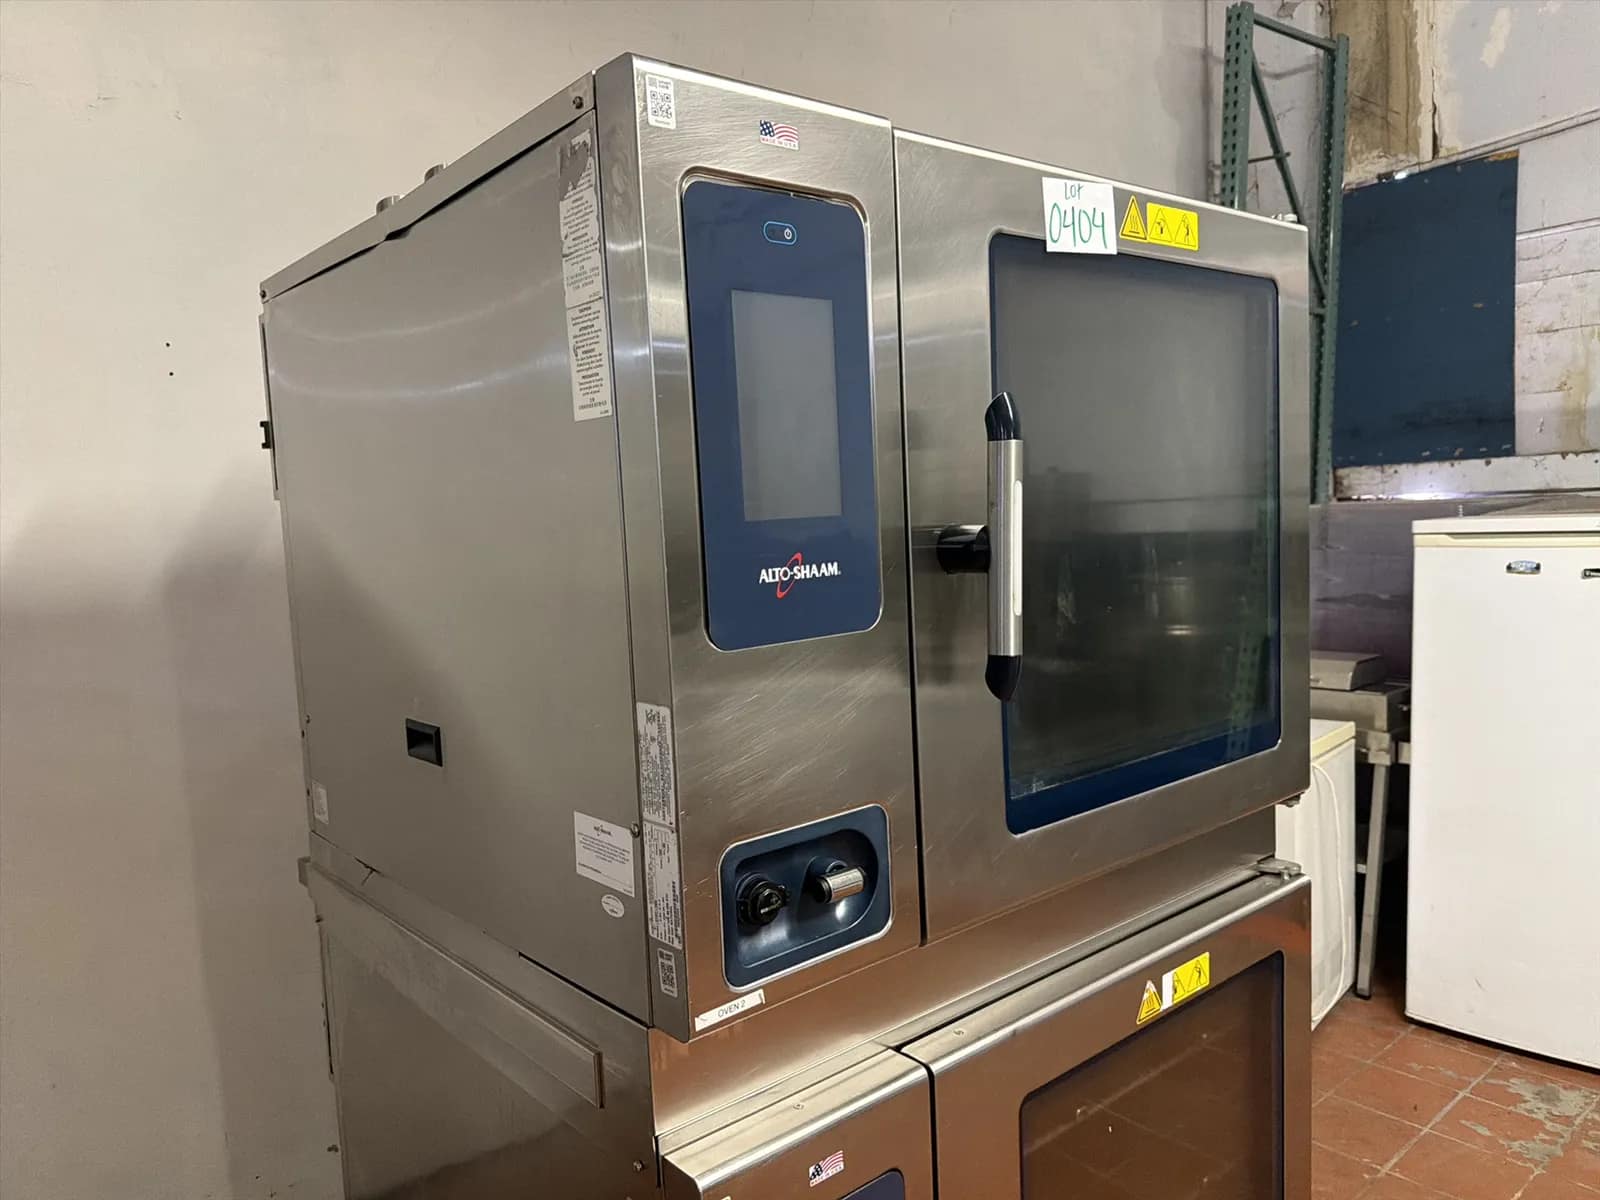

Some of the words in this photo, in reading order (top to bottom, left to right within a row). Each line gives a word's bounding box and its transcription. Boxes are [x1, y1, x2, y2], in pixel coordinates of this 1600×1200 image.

[1048, 202, 1109, 250] 0404
[717, 1001, 740, 1018] OVEN
[740, 999, 746, 1008] 2
